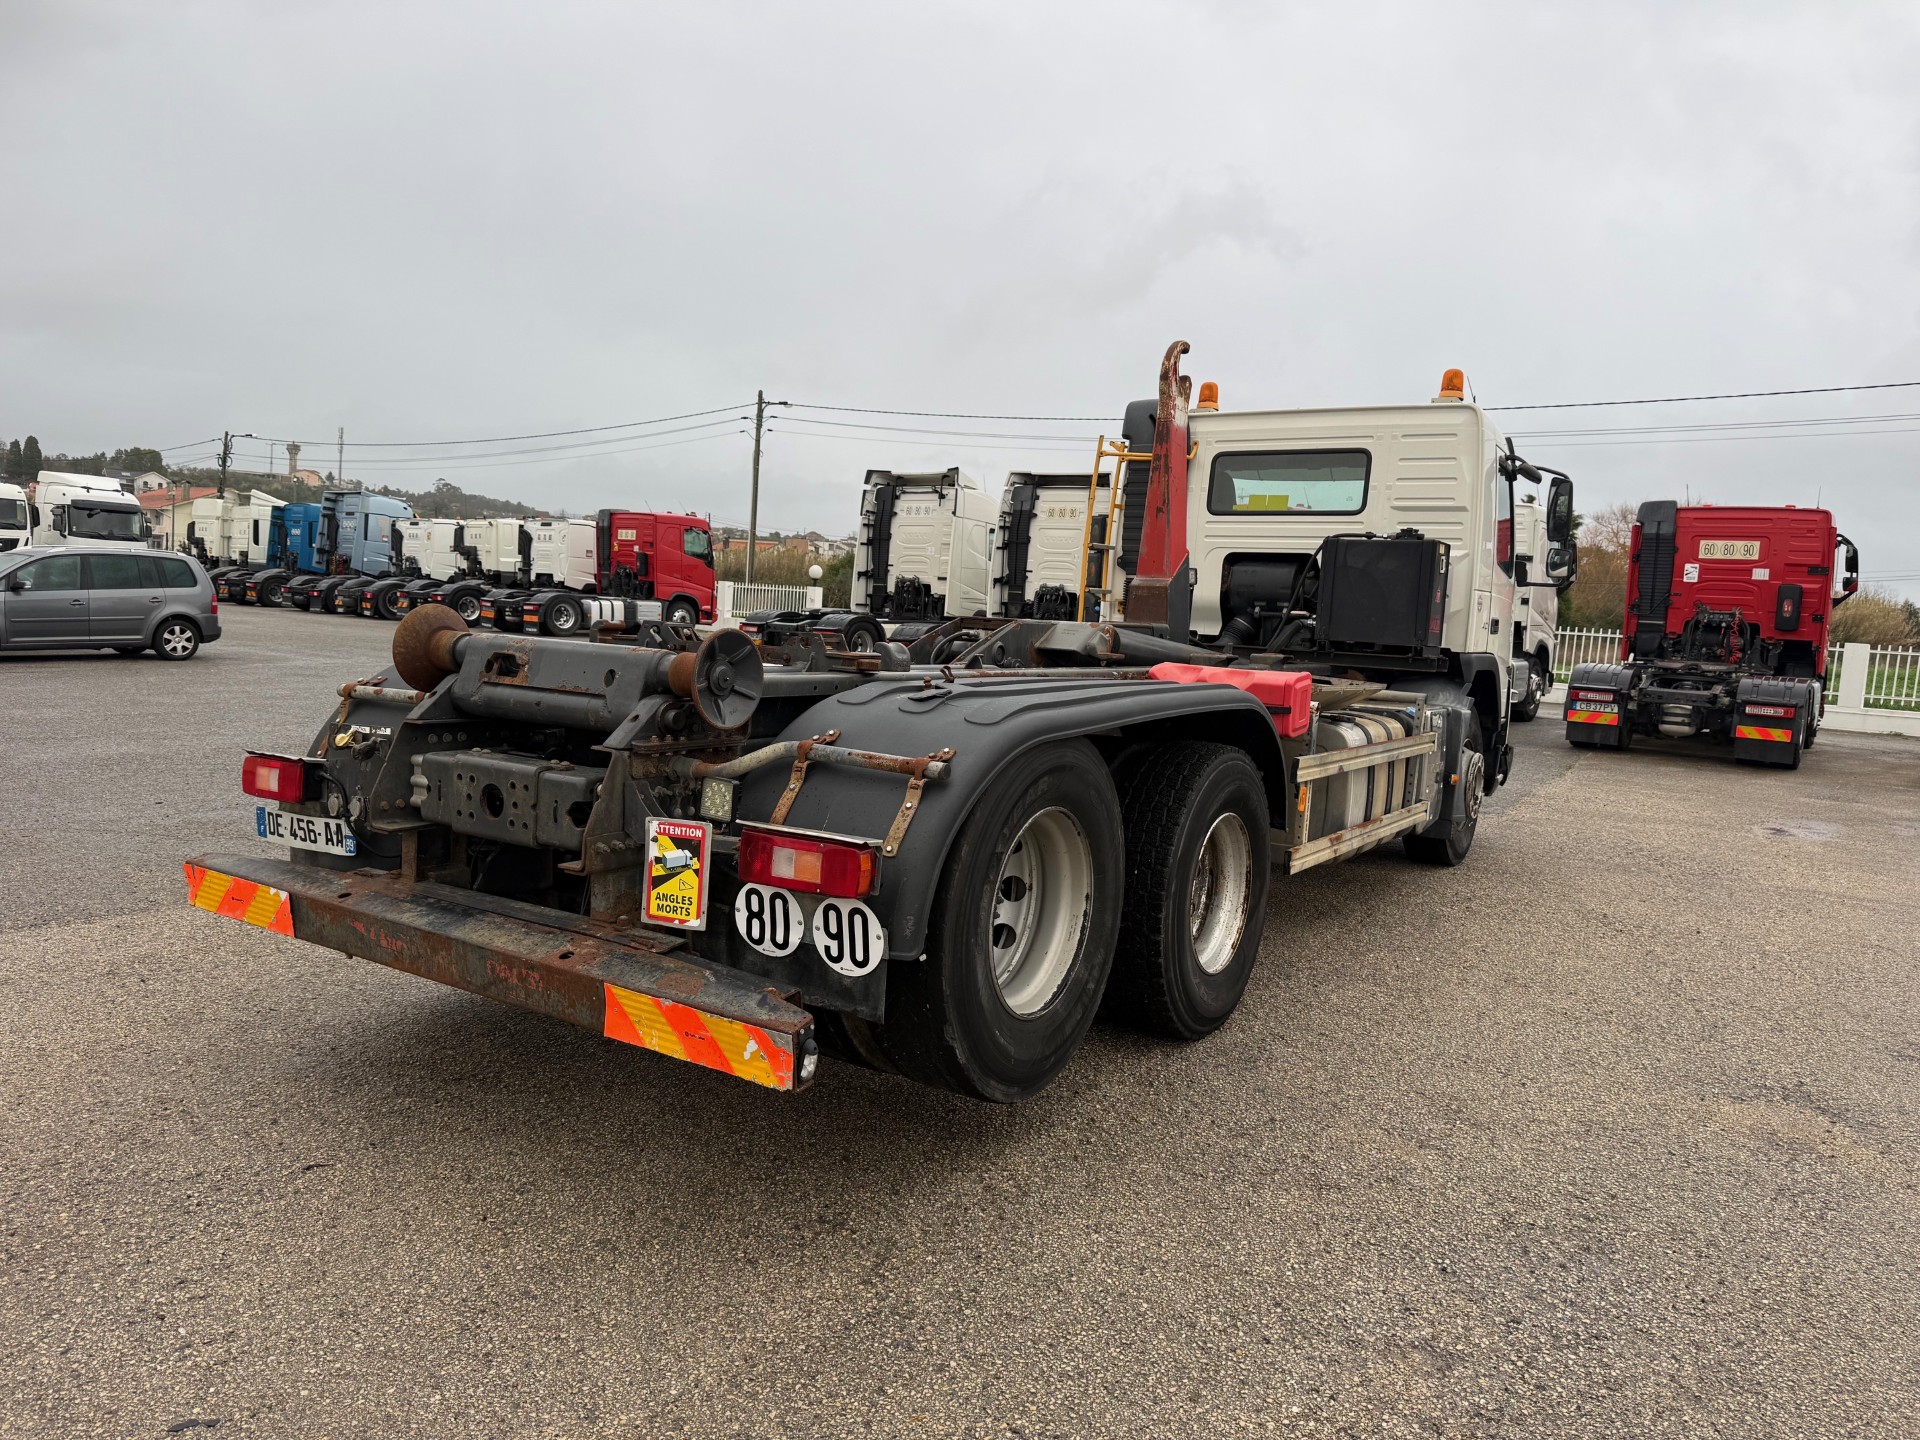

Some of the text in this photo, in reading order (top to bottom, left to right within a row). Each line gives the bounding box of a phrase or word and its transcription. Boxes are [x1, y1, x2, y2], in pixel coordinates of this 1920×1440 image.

[1703, 543, 1755, 557] 60 80 90
[655, 824, 703, 838] ATTENTION
[655, 891, 693, 906] ANGLES
[656, 902, 691, 917] MORTS
[744, 887, 791, 951] 80
[822, 902, 870, 969] 90
